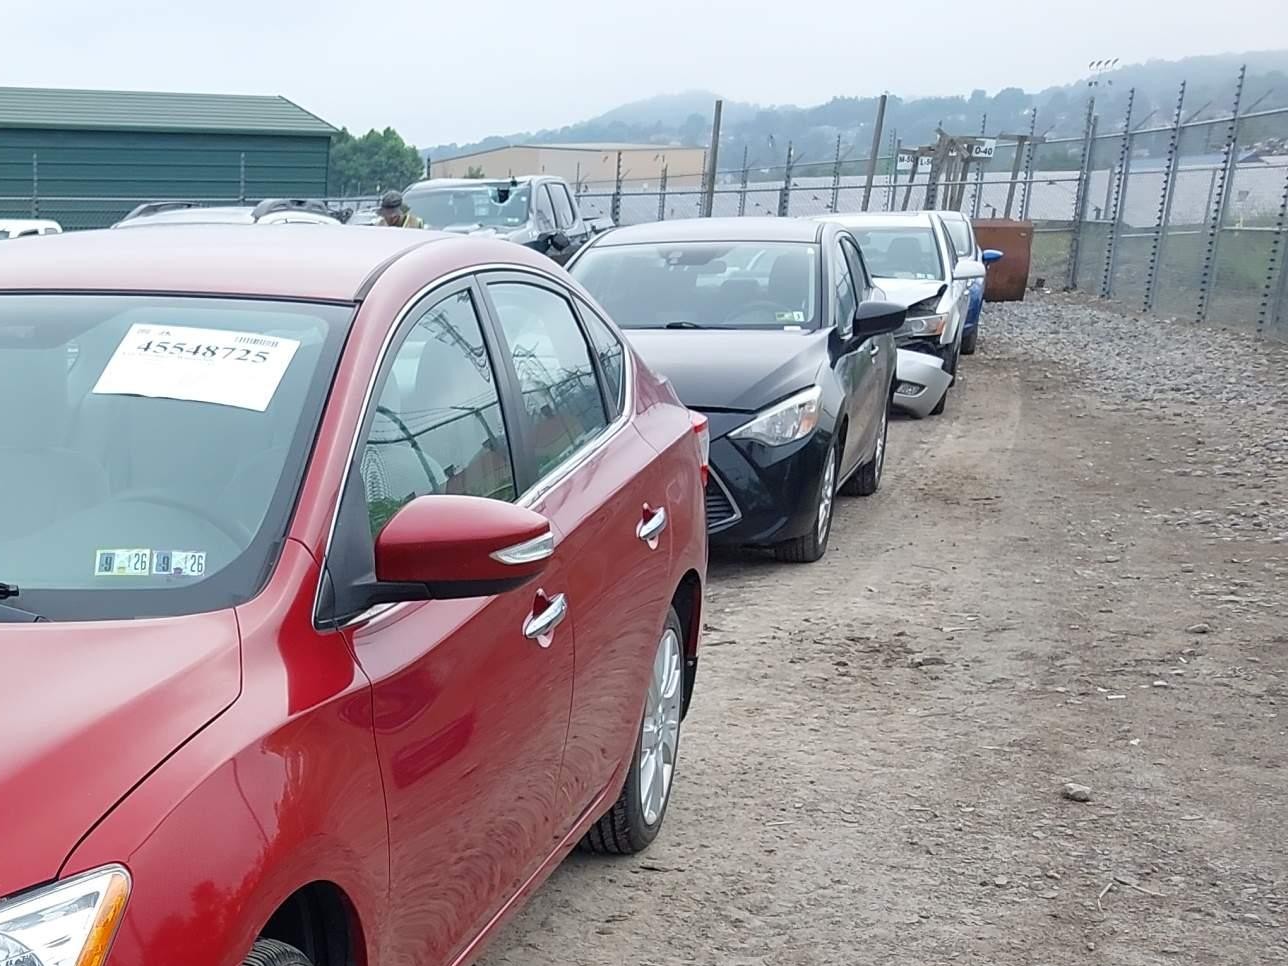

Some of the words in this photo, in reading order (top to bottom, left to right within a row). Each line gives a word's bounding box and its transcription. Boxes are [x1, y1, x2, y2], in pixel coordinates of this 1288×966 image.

[136, 340, 270, 364] 45548725
[133, 552, 147, 571] 26
[190, 554, 204, 573] 26
